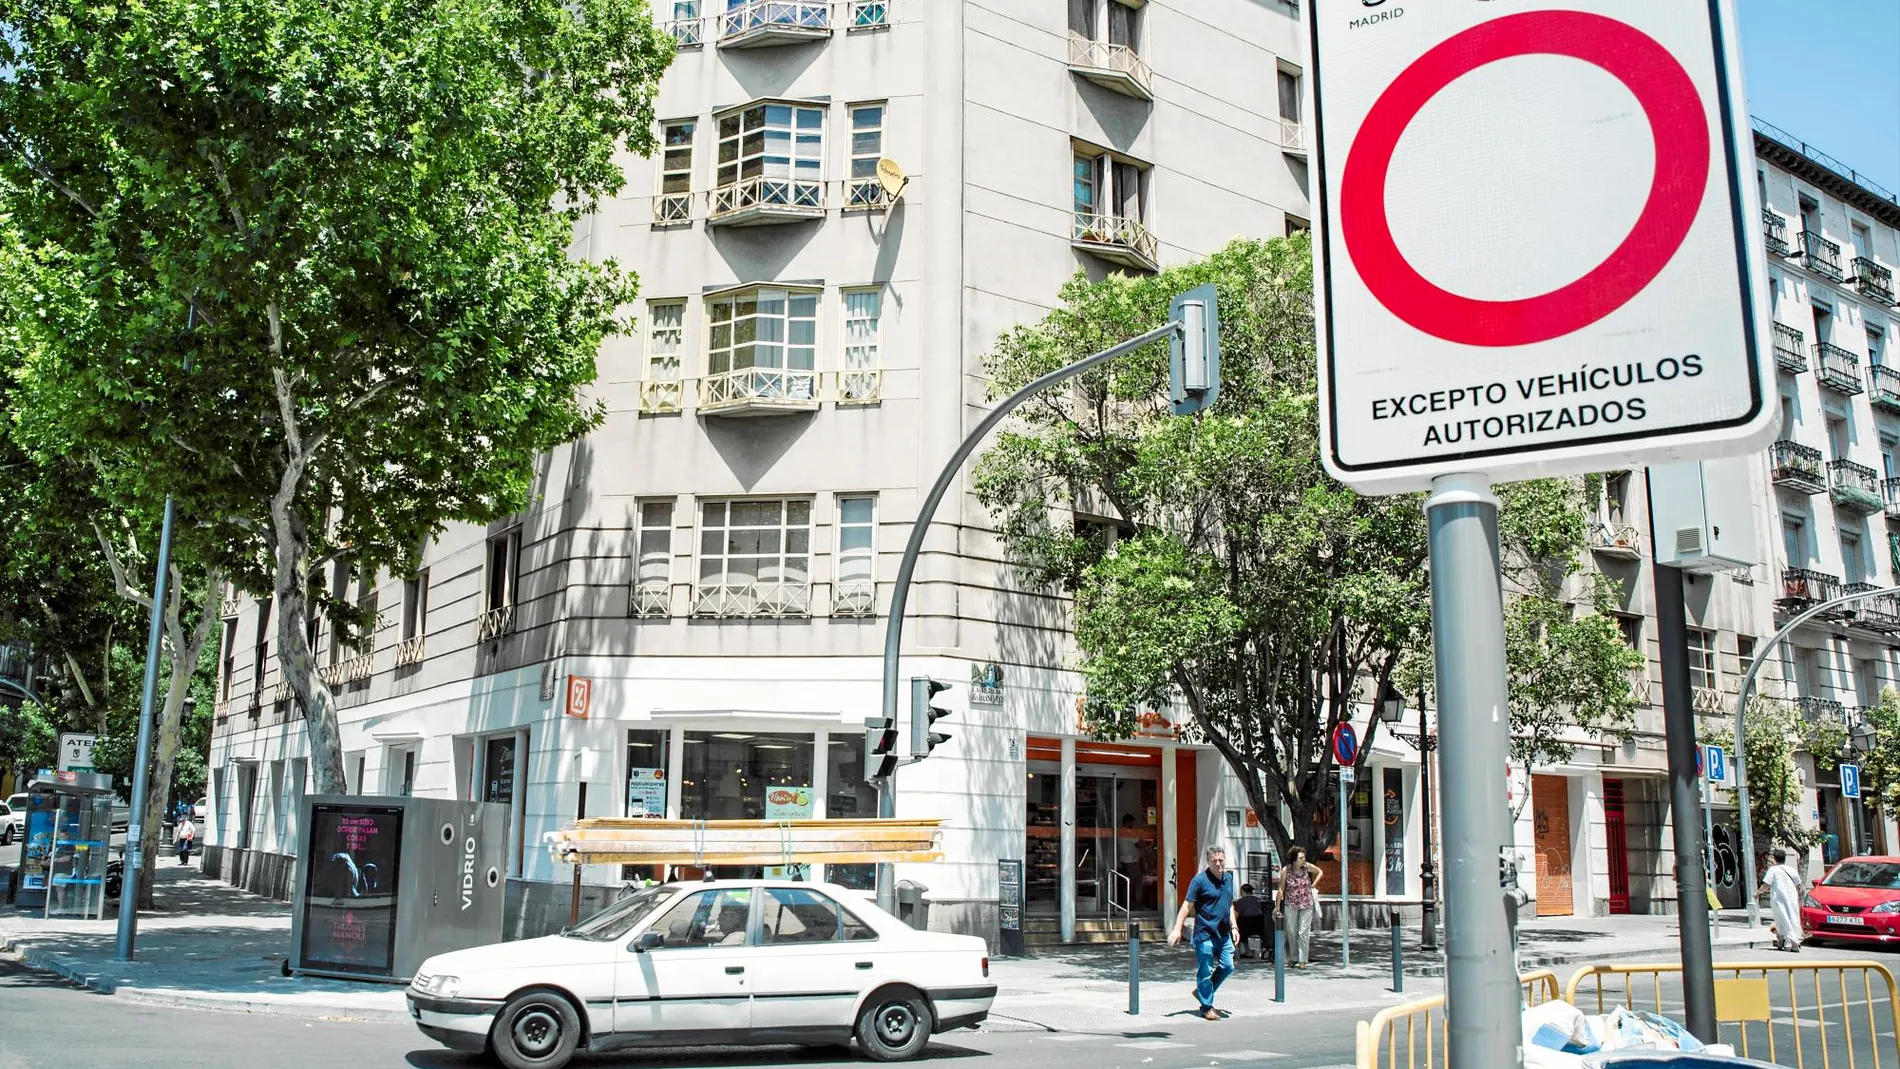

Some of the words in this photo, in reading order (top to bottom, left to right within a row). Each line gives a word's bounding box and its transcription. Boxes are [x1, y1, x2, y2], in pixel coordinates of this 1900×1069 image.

[1349, 7, 1404, 29] MADRID
[1372, 383, 1507, 420] EXCEPTO
[1516, 354, 1704, 400] VEHÍCULOS
[1423, 397, 1647, 446] AUTORIZADOS
[462, 837, 476, 910] VIDRIO
